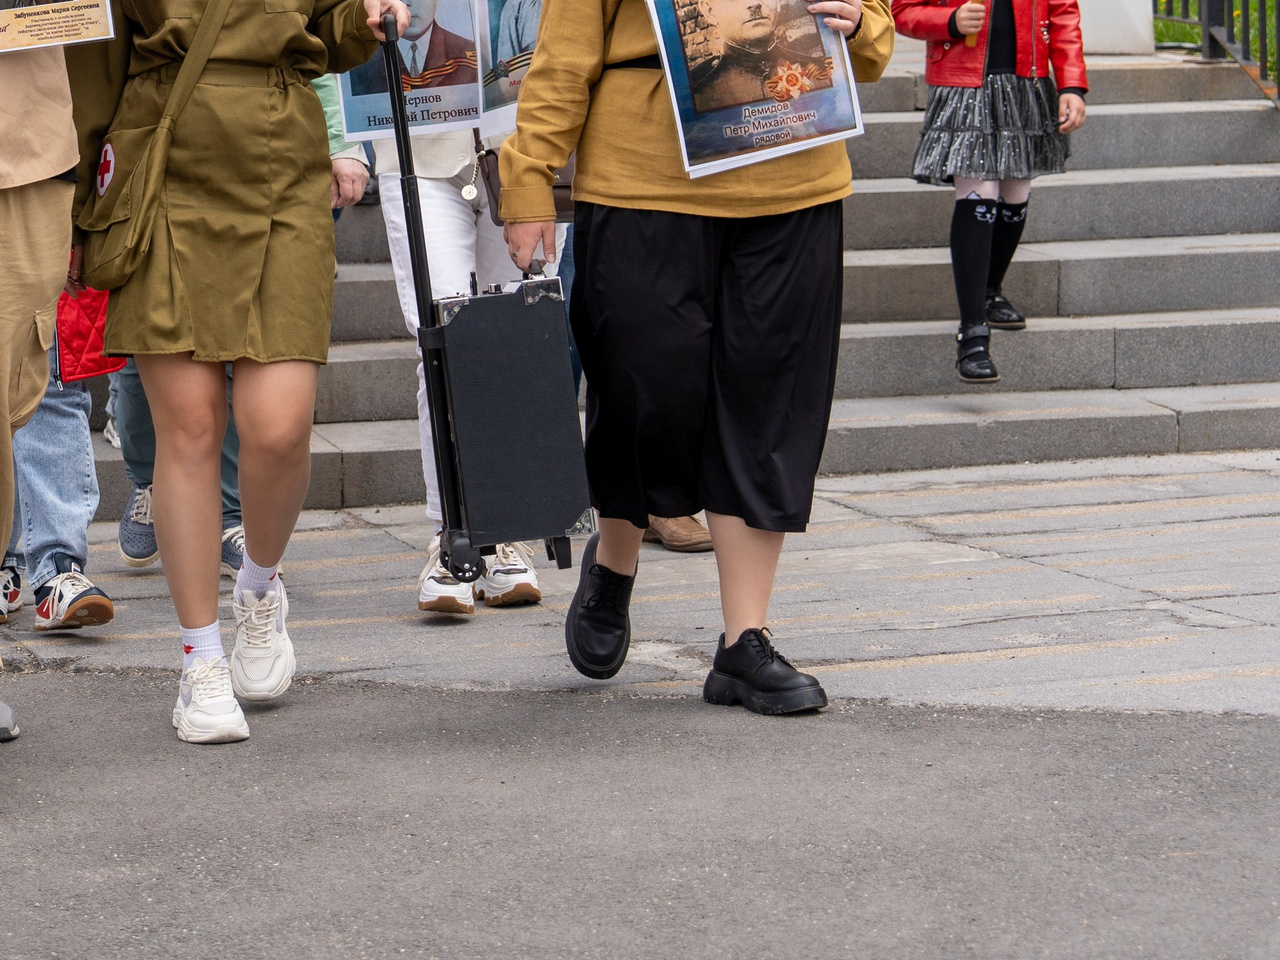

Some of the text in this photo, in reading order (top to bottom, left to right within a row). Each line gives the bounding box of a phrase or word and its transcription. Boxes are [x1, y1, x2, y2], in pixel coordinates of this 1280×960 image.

[51, 6, 70, 14] Мария
[71, 3, 99, 11] Сергеевна
[421, 106, 479, 122] Петрович
[743, 102, 789, 120] Демидов
[724, 111, 817, 137] Петр Михайлович
[754, 130, 791, 146] рядовой
